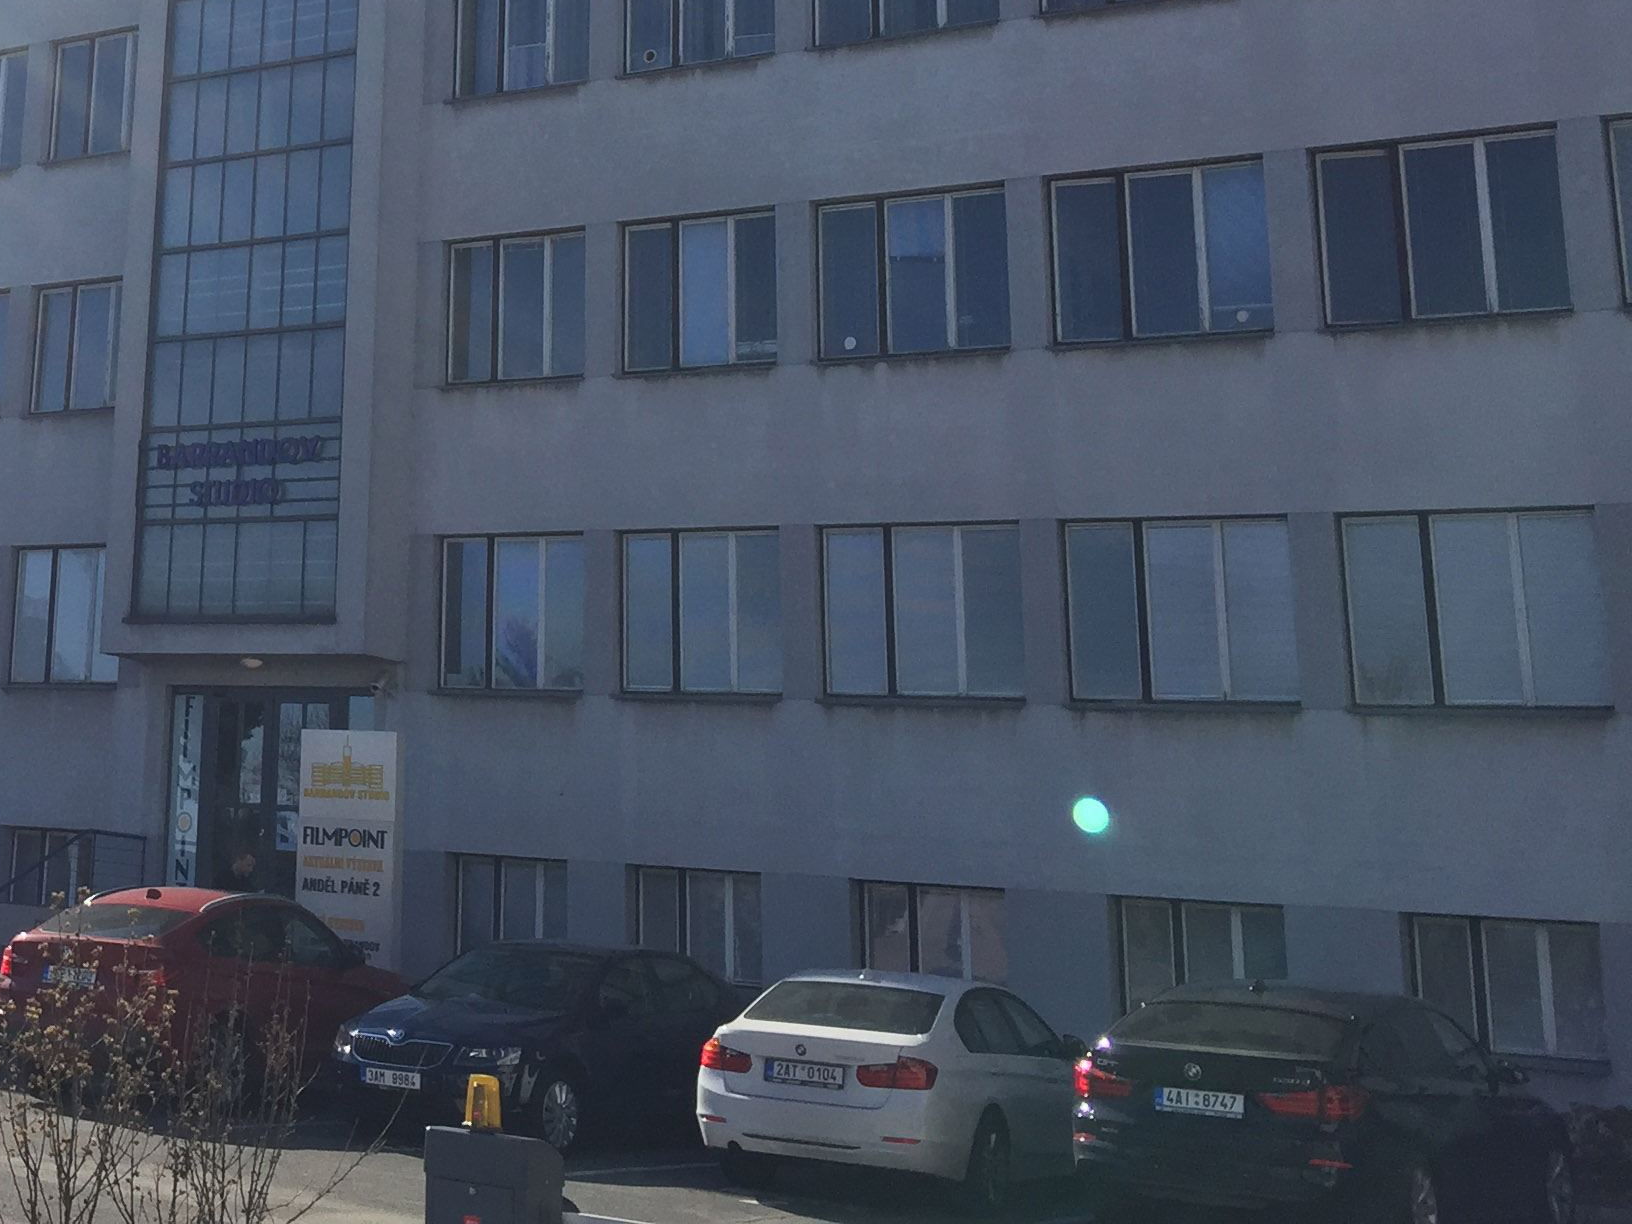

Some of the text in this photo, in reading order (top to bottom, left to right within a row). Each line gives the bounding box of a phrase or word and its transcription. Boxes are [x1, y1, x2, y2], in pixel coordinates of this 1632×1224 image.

[157, 435, 321, 469] BARRANDOV
[189, 477, 280, 507] STUDIO
[175, 695, 196, 887] FILMPOIN
[303, 826, 388, 849] FILMPOINT
[302, 877, 381, 896] ANDĚL PÁNĚ 2
[368, 1069, 386, 1084] 3AM
[776, 1062, 837, 1082] 2AT 0104
[1202, 1093, 1237, 1110] 8747
